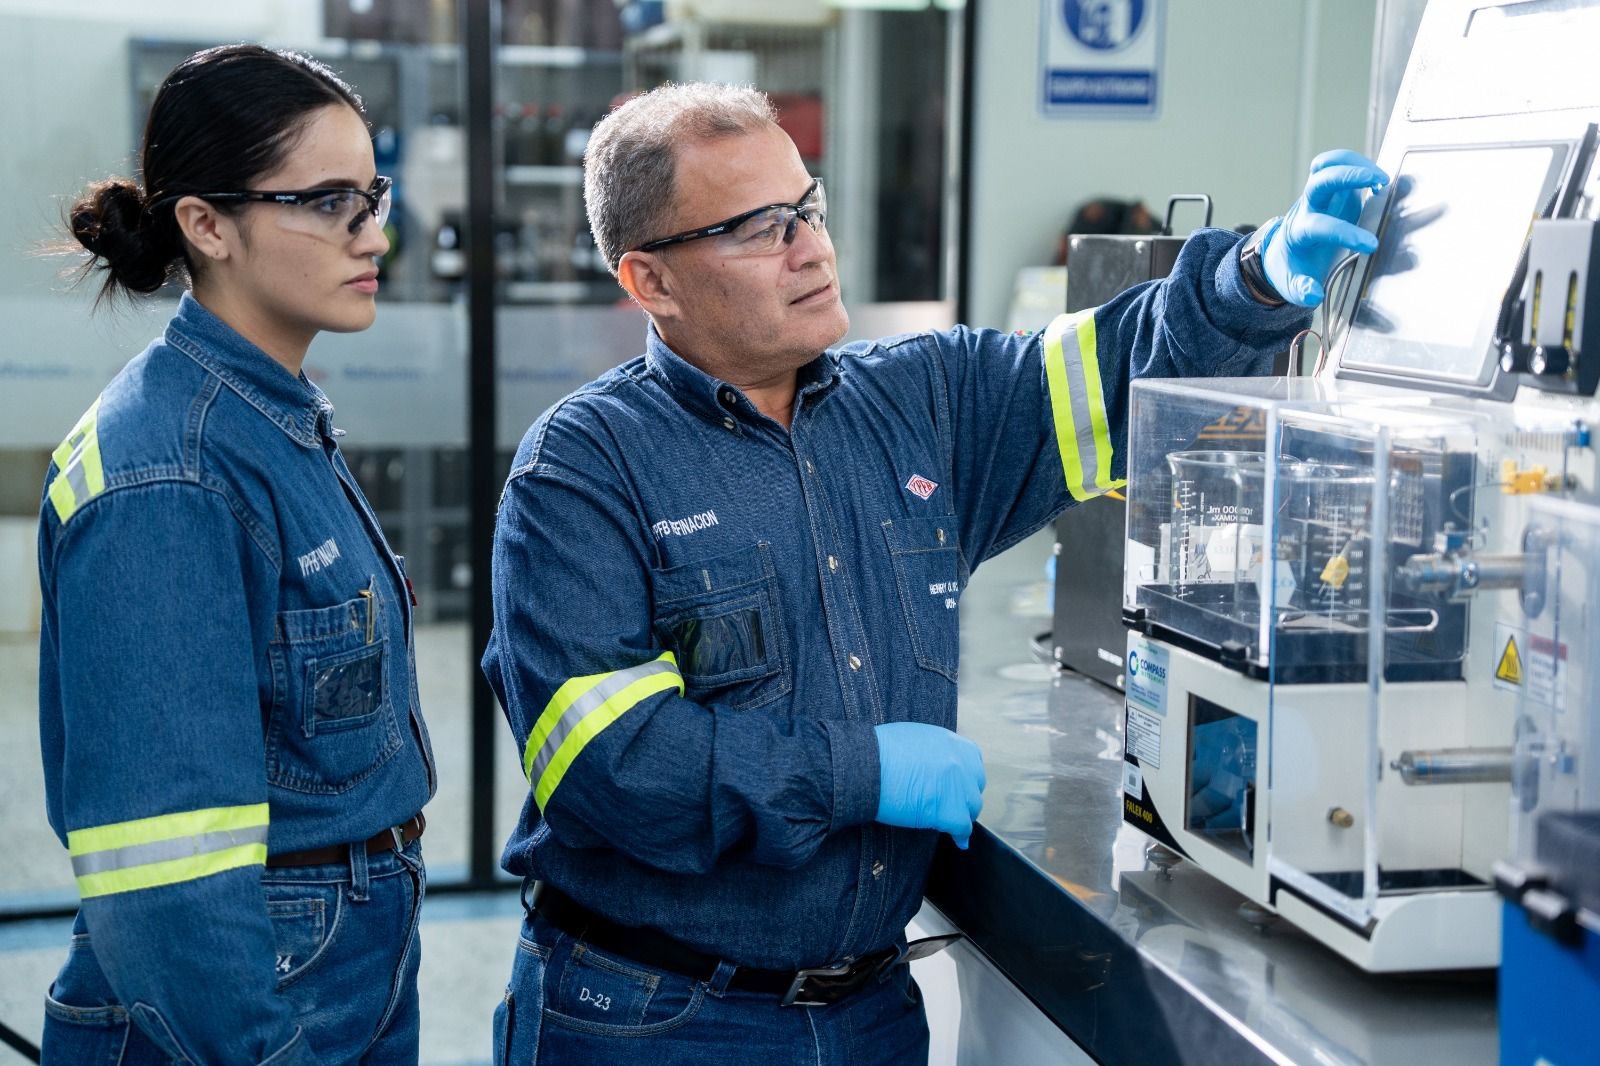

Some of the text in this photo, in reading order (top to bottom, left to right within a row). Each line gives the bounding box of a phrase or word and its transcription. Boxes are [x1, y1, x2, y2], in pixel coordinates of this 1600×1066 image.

[651, 519, 671, 542] PFB
[1140, 659, 1166, 679] COMPASS
[1126, 799, 1153, 824] FALEX 400
[580, 986, 611, 1010] D-23
